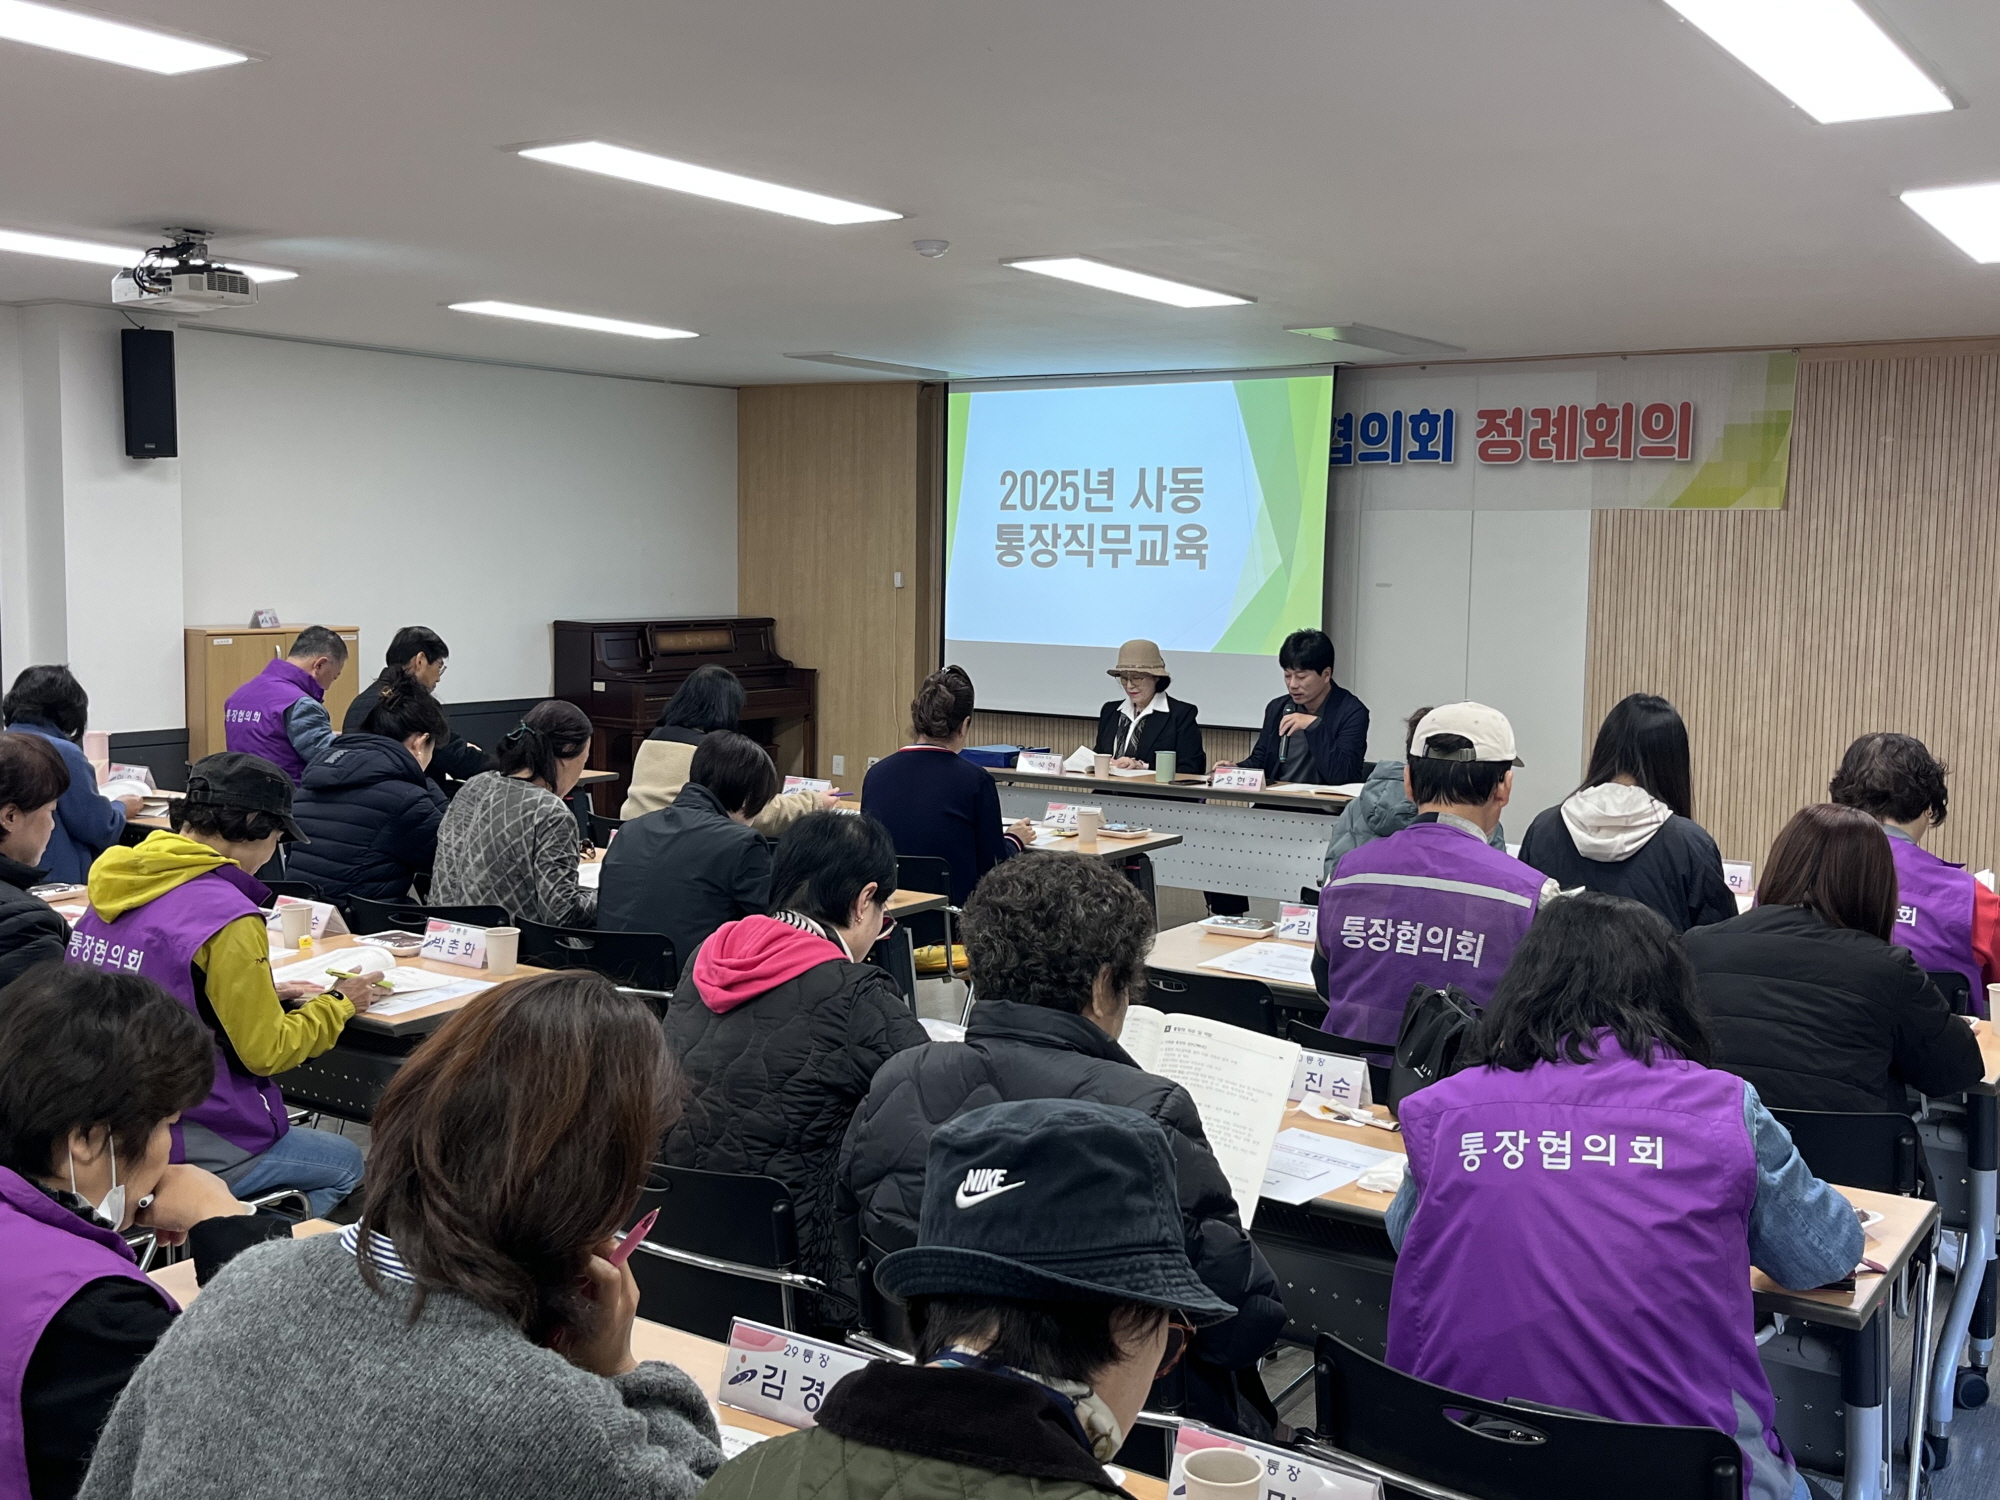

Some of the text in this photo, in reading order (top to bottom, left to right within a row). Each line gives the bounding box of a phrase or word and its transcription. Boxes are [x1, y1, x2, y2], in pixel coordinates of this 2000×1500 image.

[1475, 401, 1693, 465] 정례회의
[1000, 467, 1204, 514] 2025년 사동
[995, 523, 1209, 570] 통장직무교육
[226, 708, 262, 723] 통장협의회
[1297, 920, 1311, 935] 김
[1896, 905, 1917, 926] 회
[68, 930, 144, 974] 통장협의회
[1340, 915, 1485, 968] 통장협의회
[1291, 1071, 1350, 1099] 진순
[1458, 1129, 1663, 1172] 통장협의회
[963, 1168, 1008, 1192] NIKE
[760, 1364, 825, 1413] 김경
[1255, 1455, 1302, 1482] 통장
